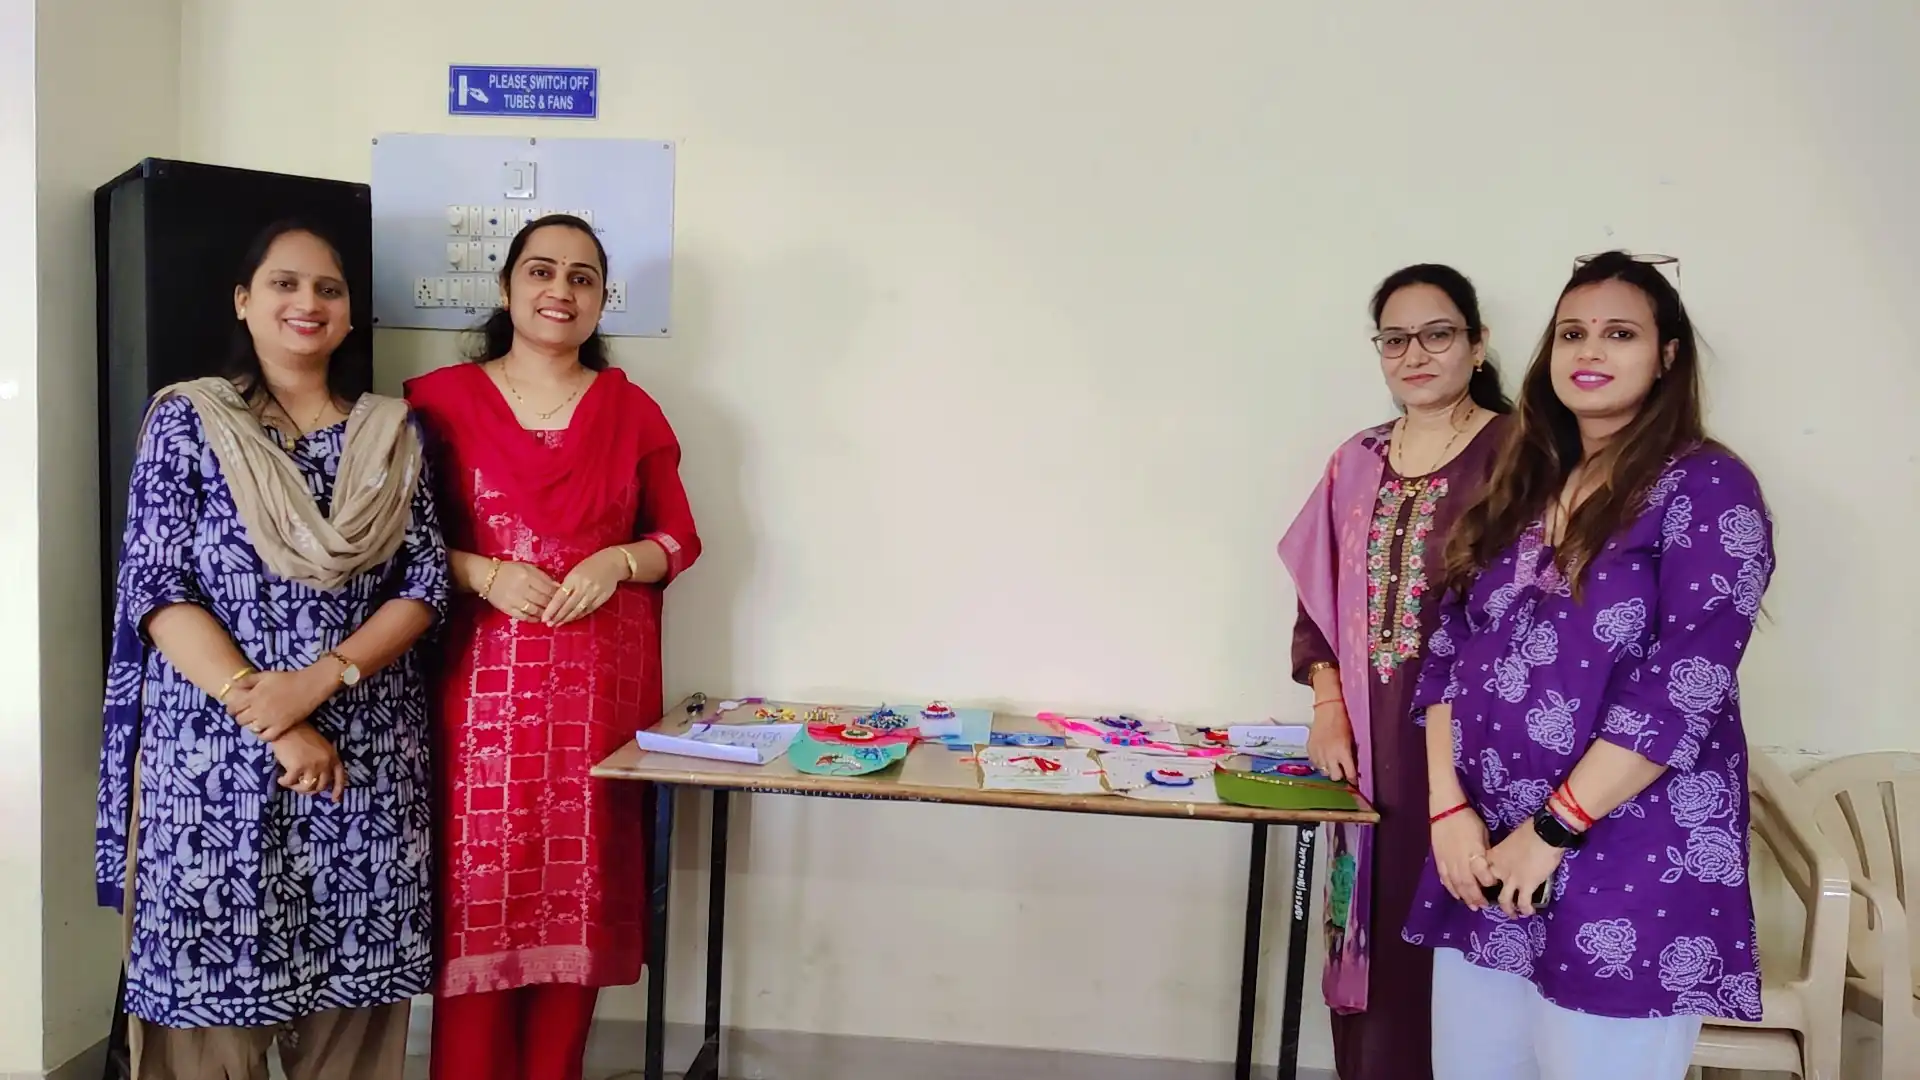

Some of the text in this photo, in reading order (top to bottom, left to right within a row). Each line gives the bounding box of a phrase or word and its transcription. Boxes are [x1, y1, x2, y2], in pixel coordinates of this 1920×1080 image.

[489, 74, 589, 90] PLEASE SWITCH OFF
[503, 94, 574, 110] TUBES & FANS
